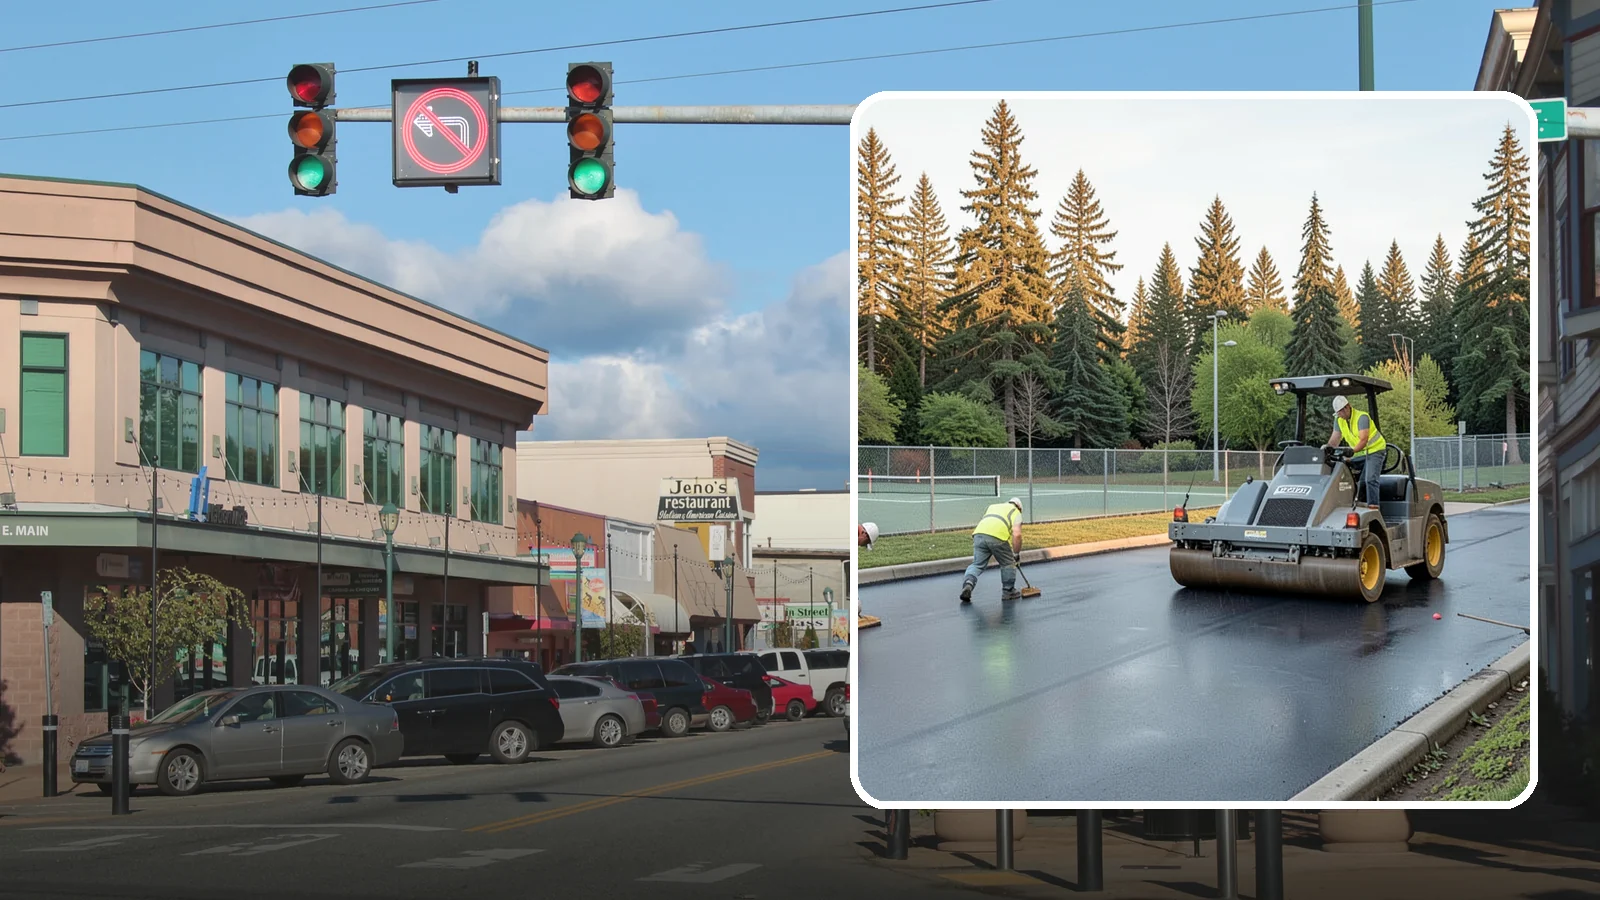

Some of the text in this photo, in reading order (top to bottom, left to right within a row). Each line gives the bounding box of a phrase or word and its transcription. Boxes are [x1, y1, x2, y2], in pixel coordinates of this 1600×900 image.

[669, 480, 728, 495] Jeno's
[665, 496, 731, 509] restaurant
[658, 510, 682, 520] Italian
[686, 510, 714, 519] American
[715, 509, 737, 519] Cuisine
[2, 525, 49, 536] E. MAIN
[797, 608, 828, 617] Street
